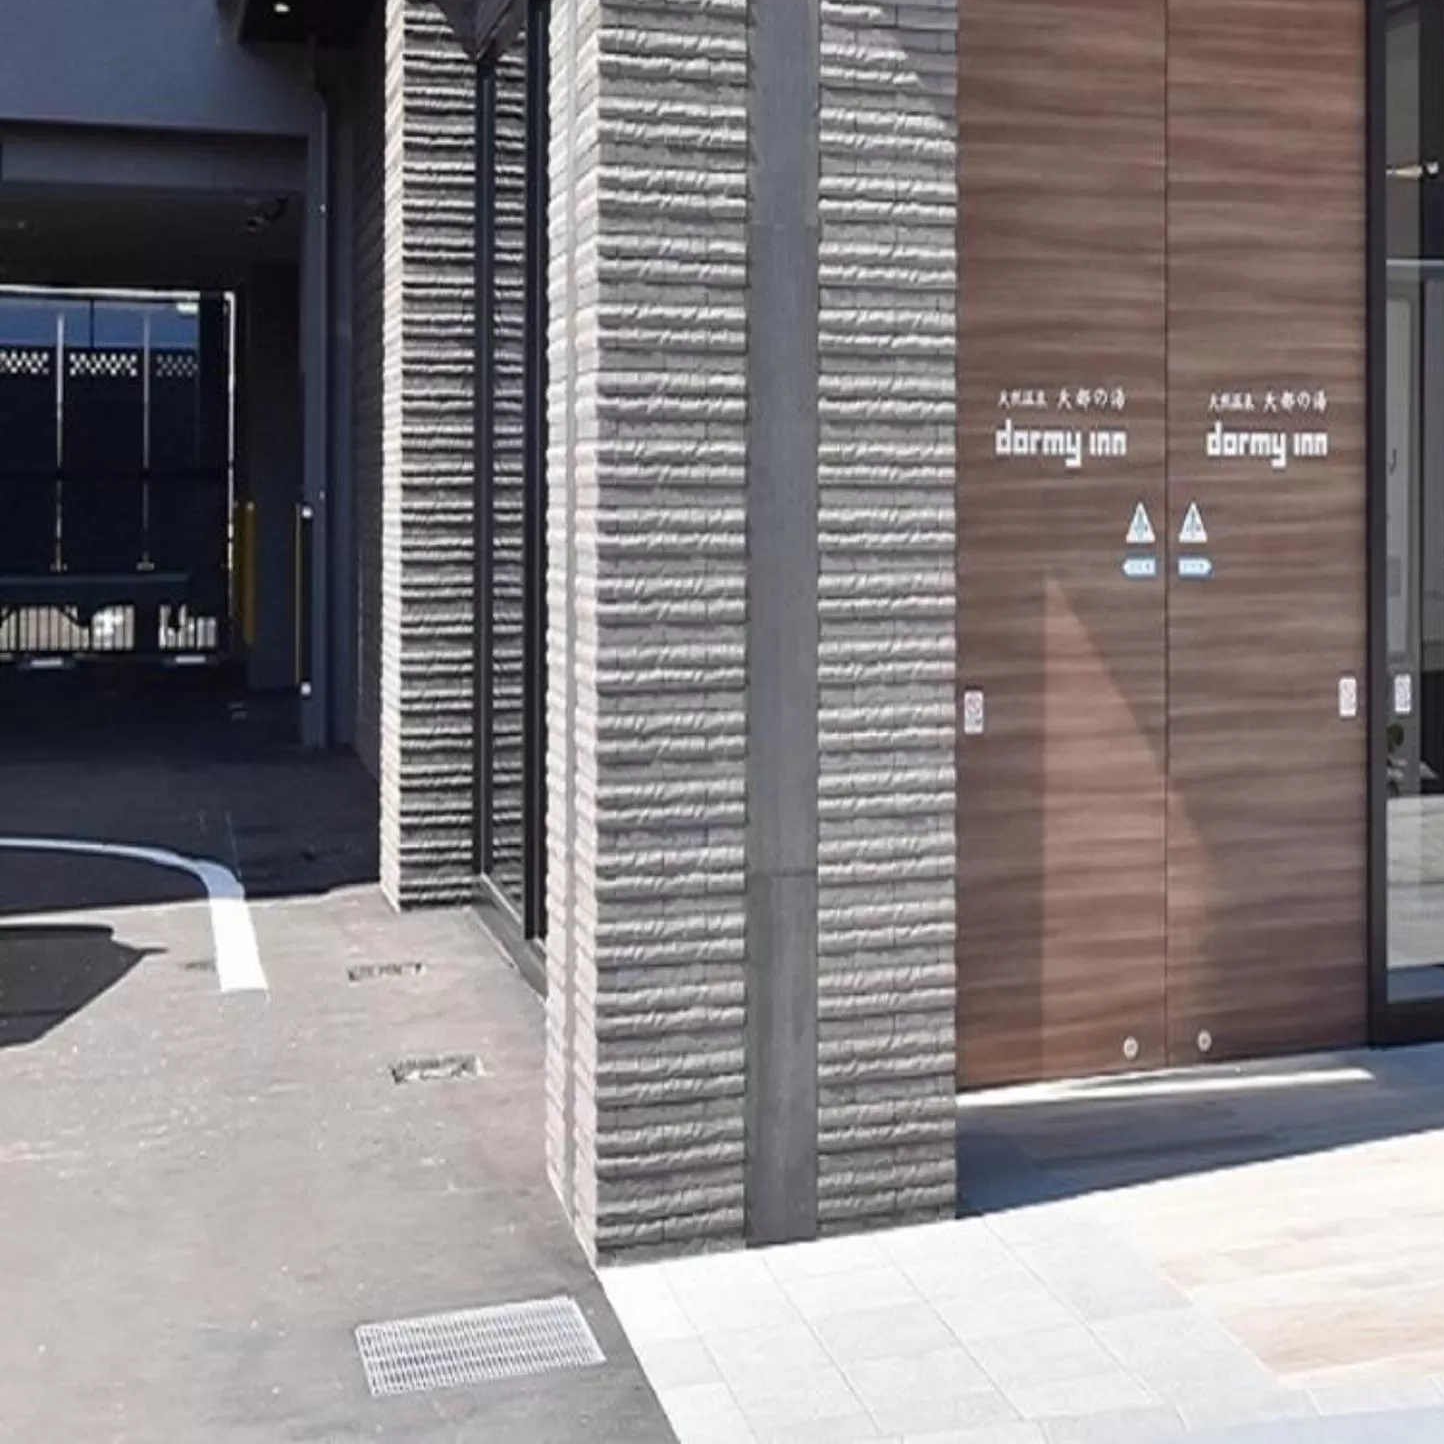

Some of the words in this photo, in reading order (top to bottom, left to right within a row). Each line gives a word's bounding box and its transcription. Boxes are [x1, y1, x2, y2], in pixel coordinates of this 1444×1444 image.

[995, 418, 1082, 468] dormy
[1088, 430, 1127, 456] inn
[1206, 420, 1287, 468] dormy
[1293, 432, 1328, 456] inn
